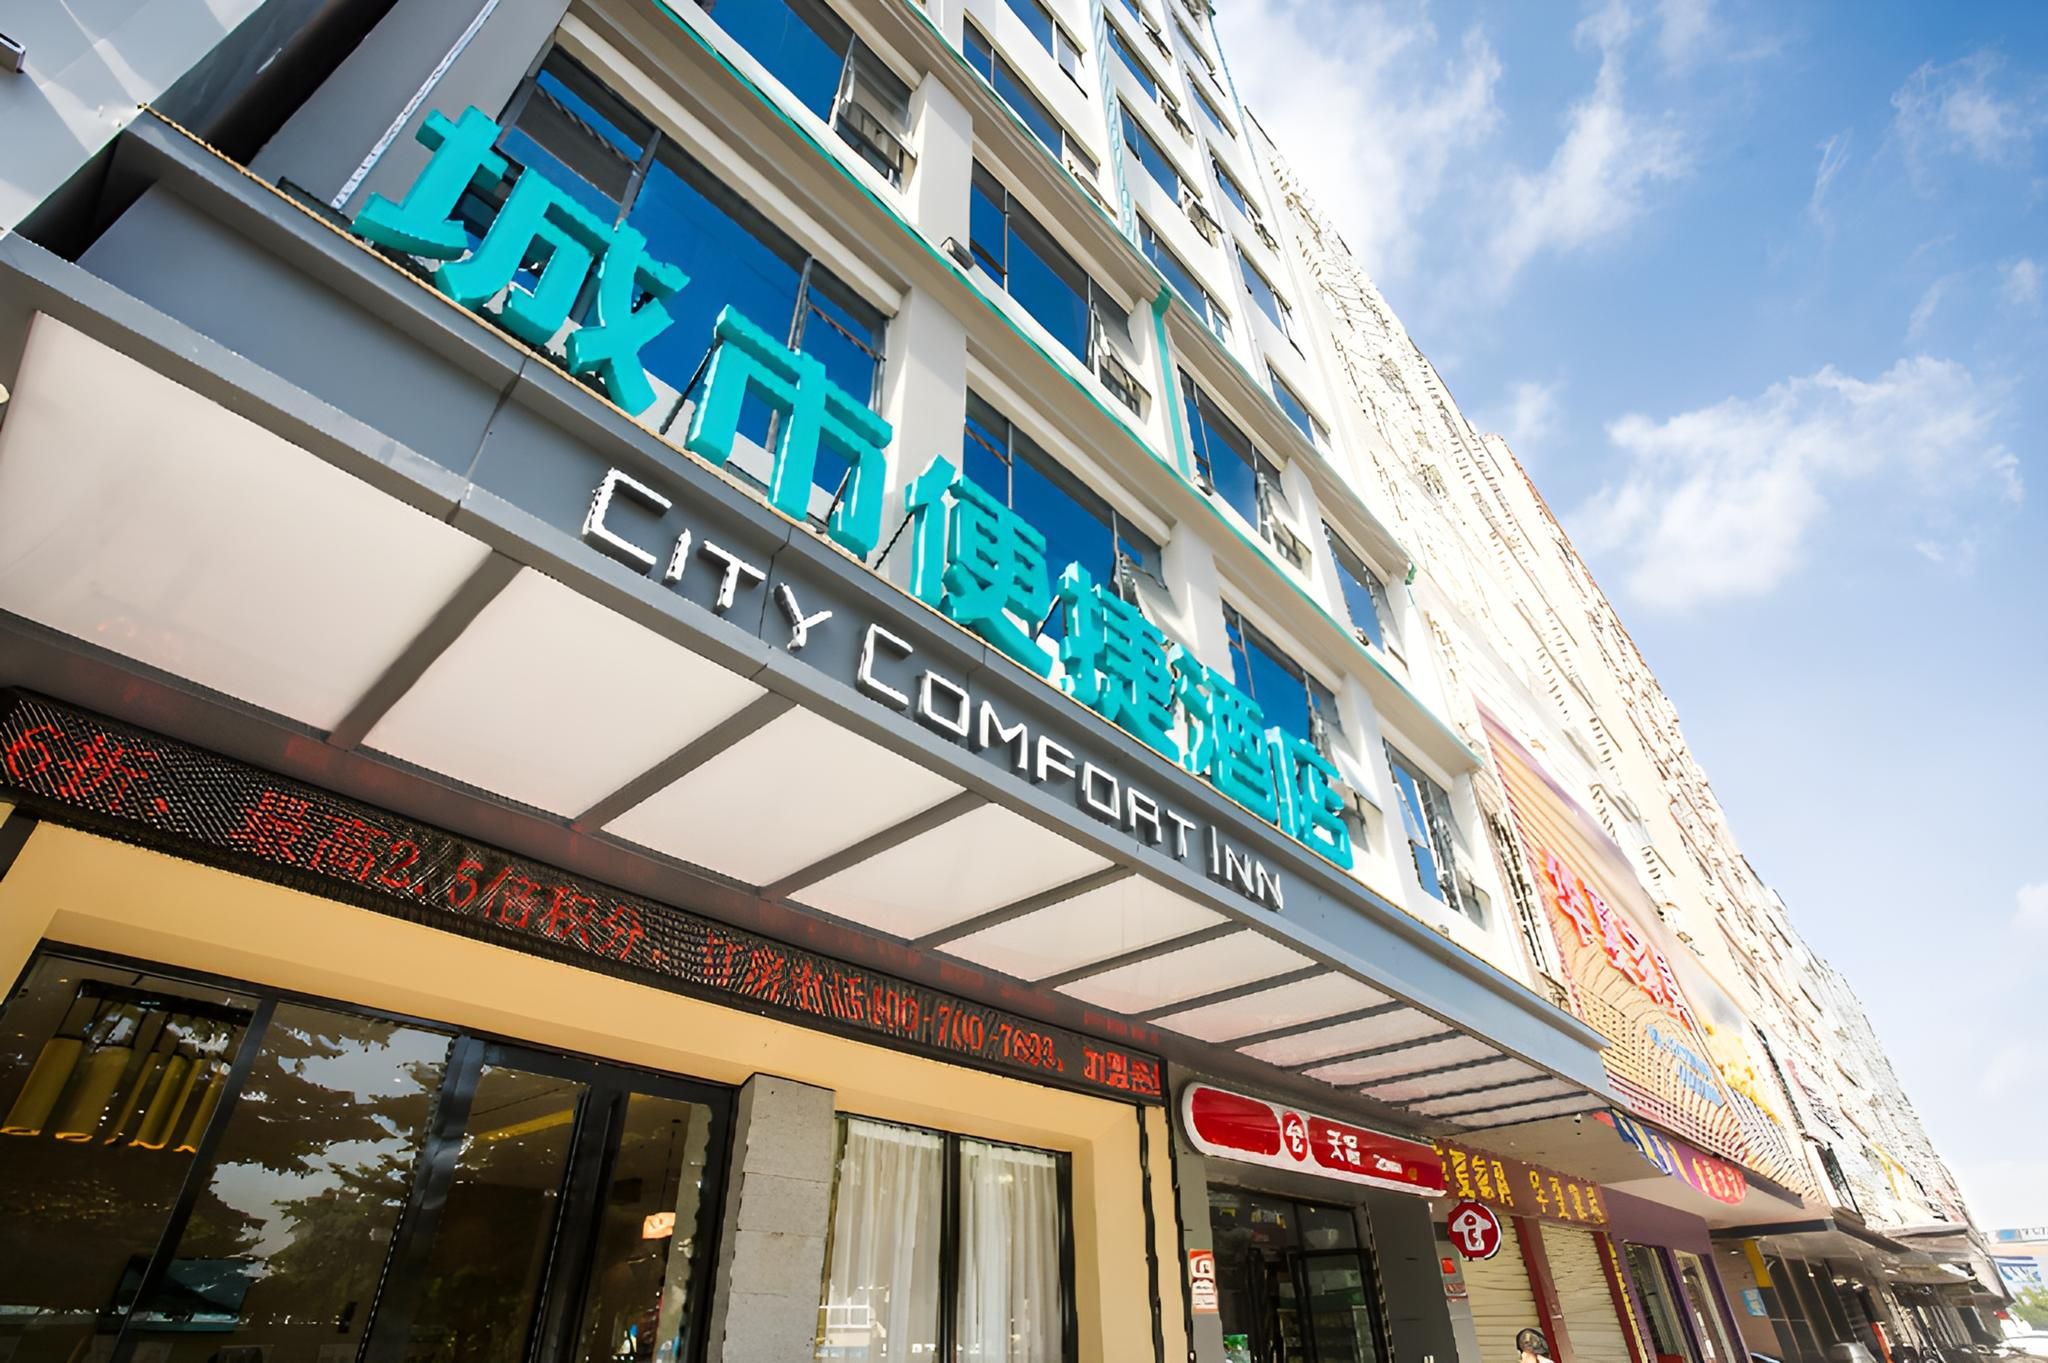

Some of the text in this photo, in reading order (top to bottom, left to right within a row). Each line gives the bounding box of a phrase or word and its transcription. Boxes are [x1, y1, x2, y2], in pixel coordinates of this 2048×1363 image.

[352, 106, 1353, 869] 城市便捷酒店
[582, 467, 1285, 911] CITY COMFORT INN
